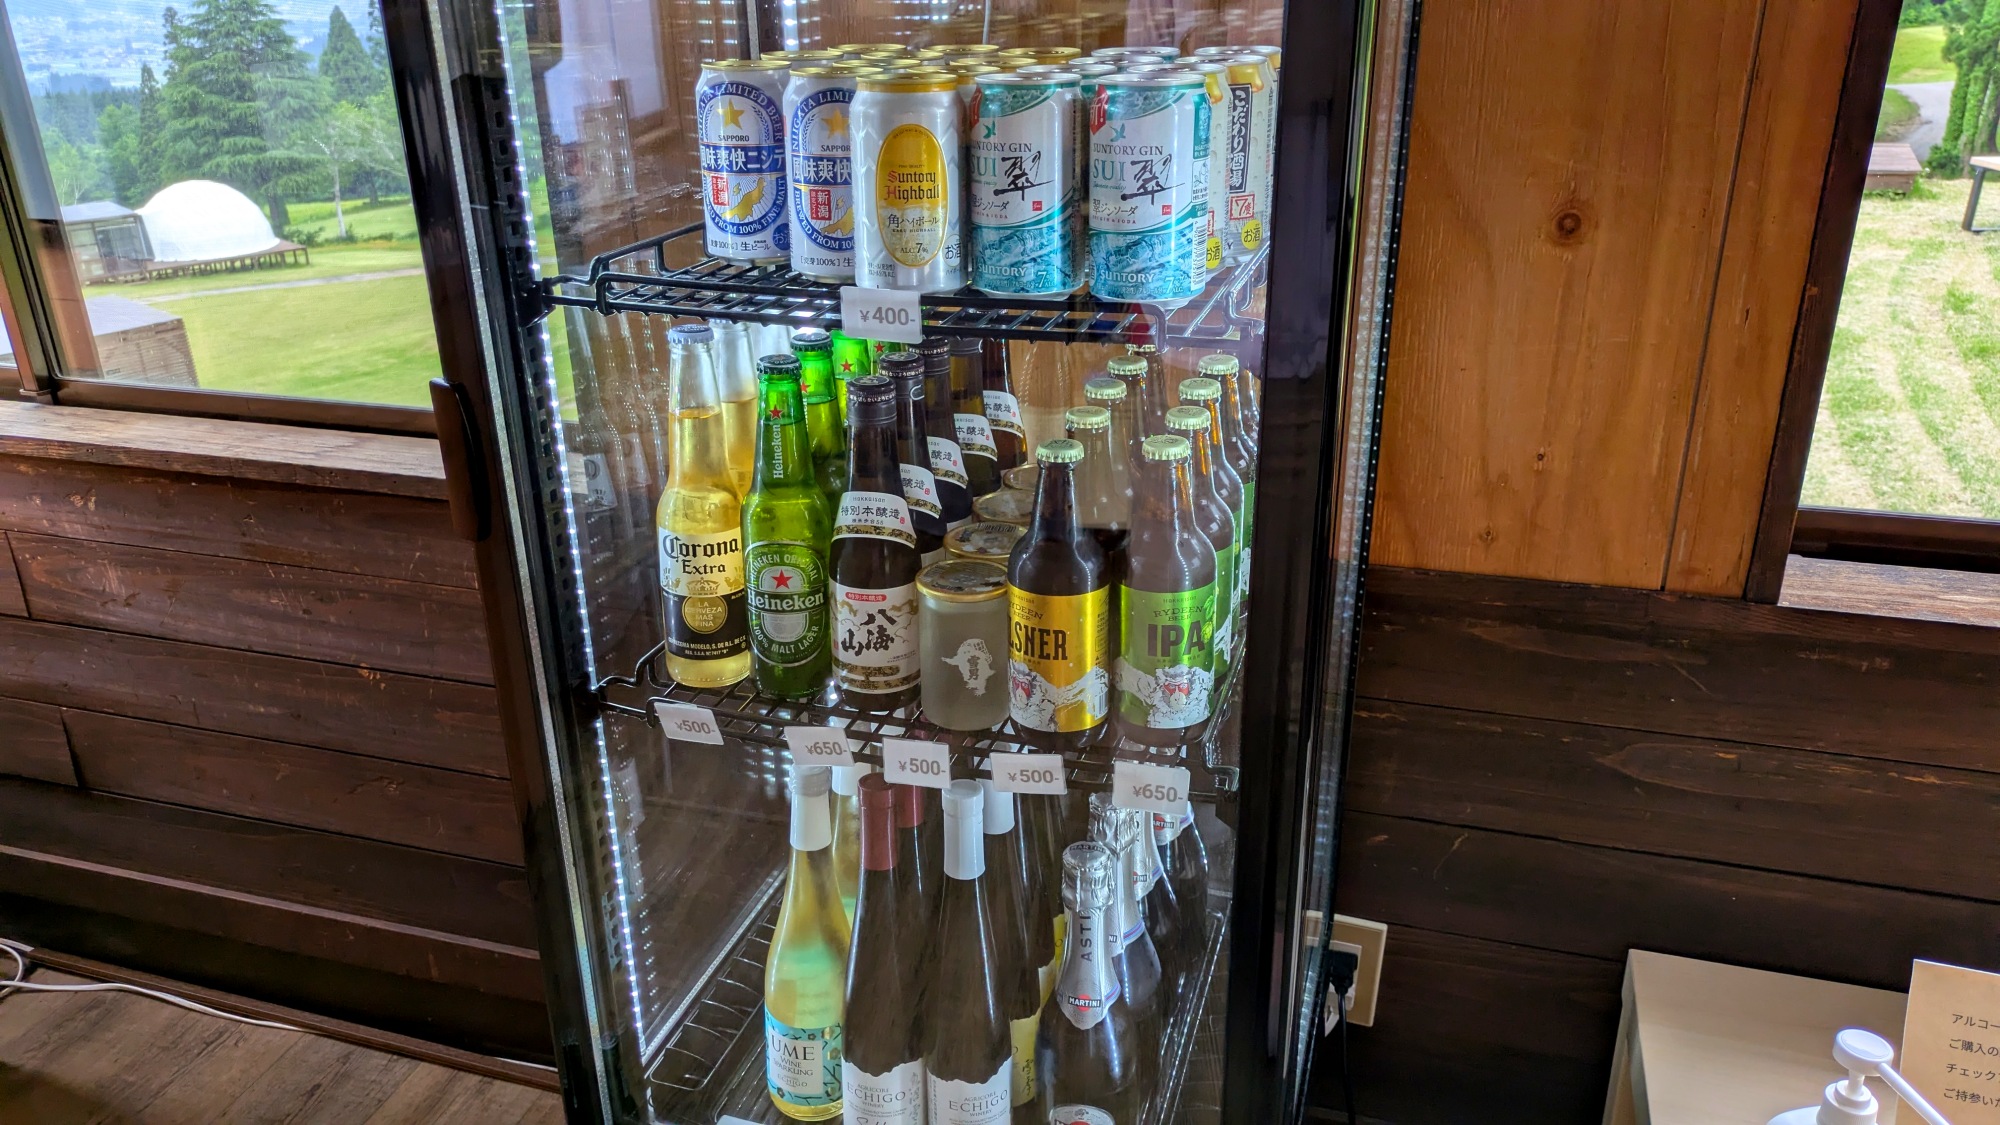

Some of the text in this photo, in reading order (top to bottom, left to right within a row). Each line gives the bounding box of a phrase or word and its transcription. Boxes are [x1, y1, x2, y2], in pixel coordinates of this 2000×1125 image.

[714, 84, 768, 106] LIMITED
[766, 105, 783, 140] BEER
[793, 90, 855, 152] NIIGATA LIMI
[718, 134, 750, 142] SAPPORO
[1231, 89, 1249, 188] こだわり酒場
[821, 144, 851, 152] SAPPOR
[1009, 142, 1032, 153] GIN
[1093, 143, 1164, 156] SUNTORY GIN
[888, 171, 936, 186] Suntory
[1093, 159, 1126, 182] SUI
[884, 184, 940, 205] Highball
[714, 178, 786, 234] FROM 100% FINE MALT
[817, 191, 829, 219] 新潟
[1092, 198, 1139, 217] 翠ジンソーダ
[888, 213, 939, 229] 角ハイボール
[812, 233, 839, 249] FROM
[1243, 226, 1261, 243] お酒
[979, 264, 1027, 277] SUNTORY
[1101, 270, 1156, 283] SUNTORY
[859, 306, 916, 326] ¥400-
[772, 424, 783, 478] Heineken
[841, 506, 901, 520] 特別本醸造
[662, 535, 740, 562] Corona
[682, 559, 726, 575] Extra
[750, 554, 780, 579] HEINEKEN
[748, 588, 825, 611] Heineken
[1153, 606, 1205, 618] RYDEEN
[754, 627, 769, 648] 100%
[771, 643, 796, 654] MALT
[799, 625, 819, 648] LAGER
[1008, 617, 1068, 660] LSNER
[1147, 620, 1205, 657] IPA
[675, 719, 716, 735] ¥500-
[805, 741, 848, 755] ¥650-
[899, 757, 946, 776] ¥500-
[1008, 769, 1060, 784] ¥500-
[1132, 784, 1183, 802] ¥650-
[1153, 820, 1174, 829] ARTINI
[1080, 914, 1092, 962] ASTI
[1069, 996, 1100, 1008] MARTINI
[1952, 1013, 2000, 1029] アルコー
[771, 1034, 815, 1061] UME
[780, 1056, 802, 1069] WINE
[1946, 1063, 2000, 1081] チェック
[847, 1082, 906, 1103] ECHIGO
[949, 1089, 1008, 1113] ECHIGO
[964, 1091, 997, 1102] AGRICORE
[862, 1101, 885, 1109] WINERY
[969, 1109, 992, 1117] WINERY
